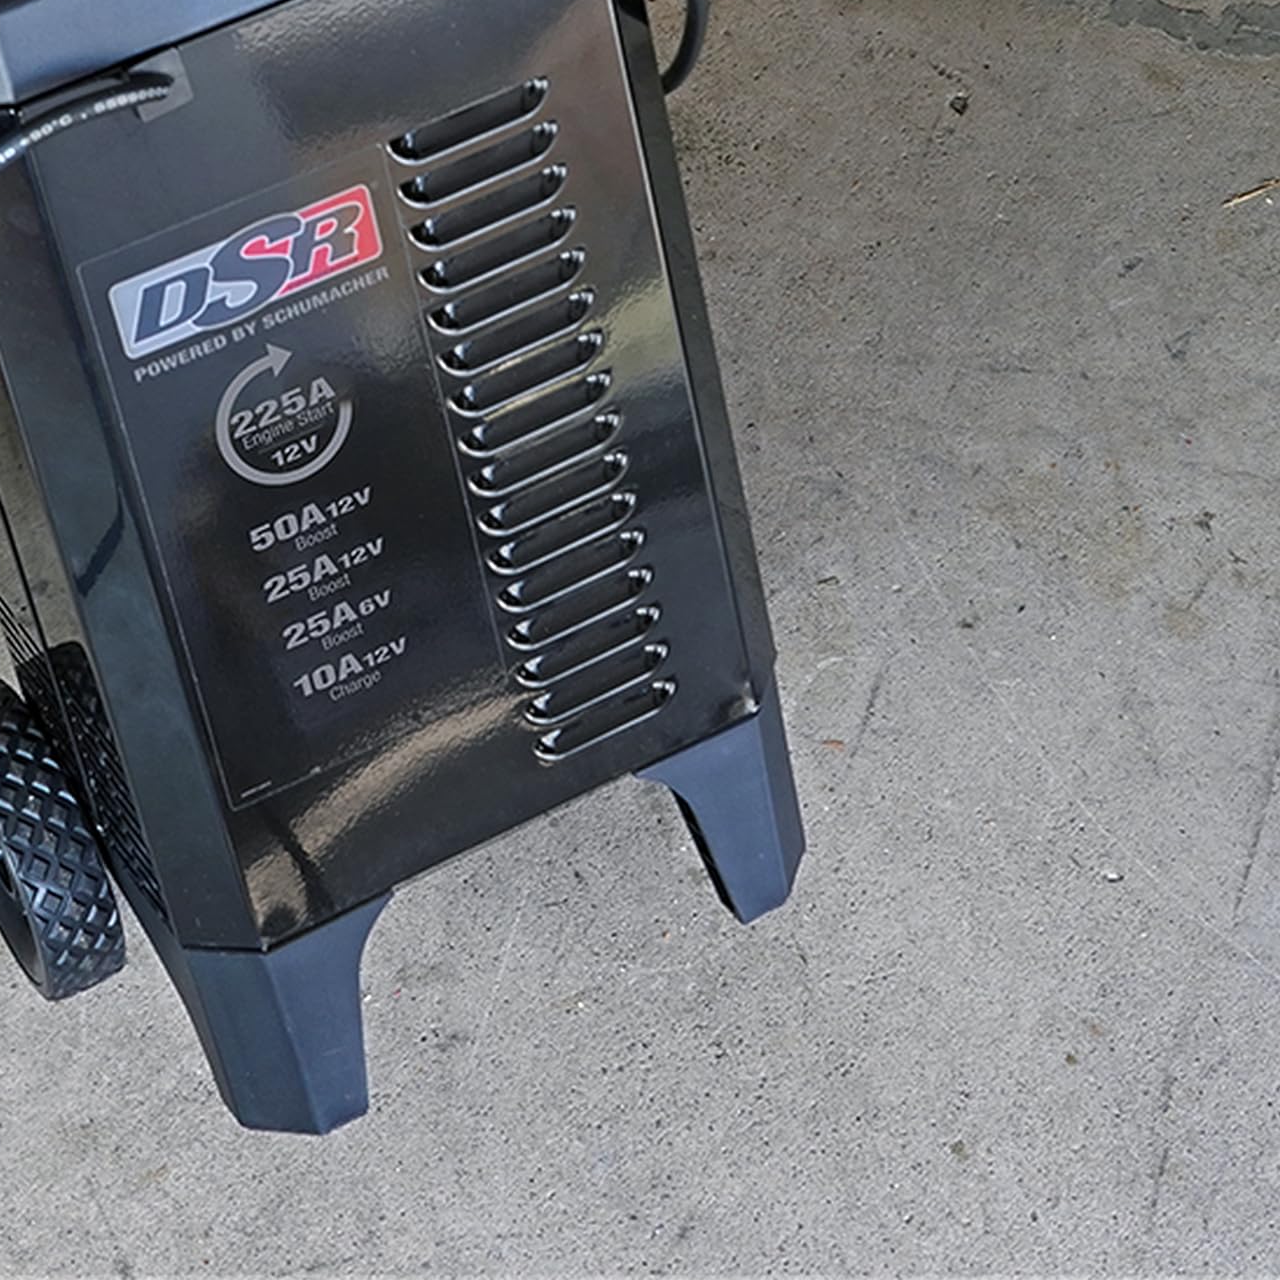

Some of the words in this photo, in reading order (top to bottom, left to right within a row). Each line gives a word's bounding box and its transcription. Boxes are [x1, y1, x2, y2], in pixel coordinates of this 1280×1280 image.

[132, 201, 364, 345] DSR
[133, 334, 227, 383] POWERED
[233, 321, 258, 343] BY
[261, 266, 391, 333] SCHUMACHER
[230, 377, 337, 439] 225A
[241, 416, 296, 451] Engine
[296, 401, 336, 428] Start
[271, 434, 319, 466] 12V
[294, 523, 340, 552] Boost
[307, 573, 353, 602] Boost
[321, 622, 366, 651] Boost
[329, 670, 382, 701] Charge
